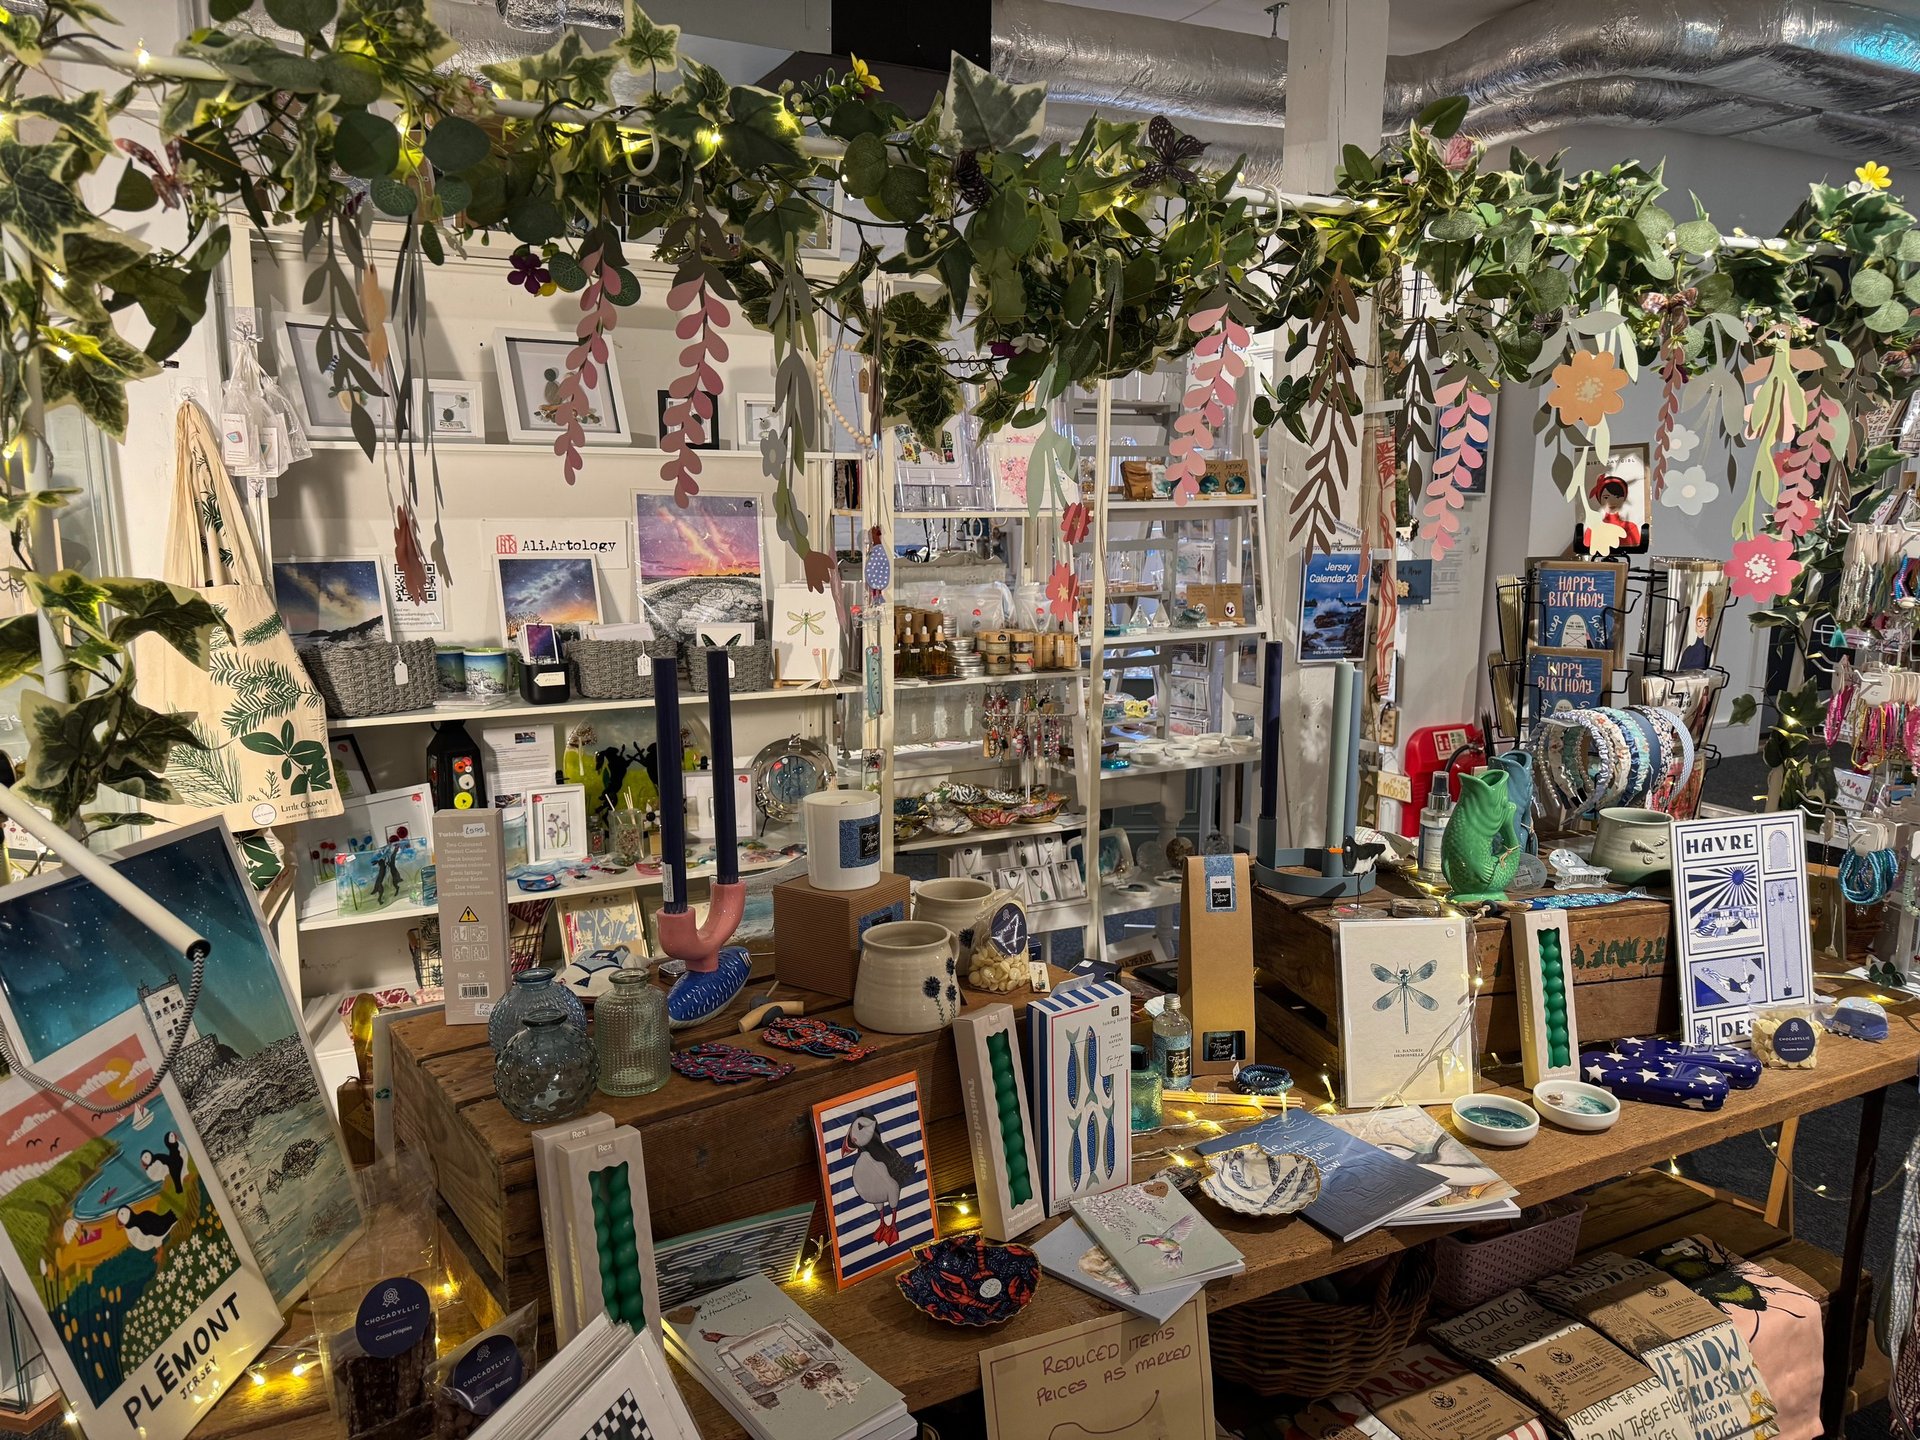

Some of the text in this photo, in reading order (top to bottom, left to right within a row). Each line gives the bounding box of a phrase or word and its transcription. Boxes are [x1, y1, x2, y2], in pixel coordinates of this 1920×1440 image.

[521, 539, 616, 553] Ali.Artology
[1309, 573, 1366, 583] Calendar 20
[1325, 562, 1352, 573] Jersey
[1558, 575, 1597, 592] HAPPY
[1548, 591, 1607, 608] BIRTHDAY
[1547, 660, 1584, 678] HAPPY
[1537, 675, 1595, 694] BIRTHDAY
[1686, 833, 1754, 855] HAVRE
[572, 1128, 587, 1139] Rex
[967, 1078, 988, 1182] Twisted Candles
[597, 1142, 613, 1153] Rex
[1569, 1276, 1604, 1295] OWLS
[1604, 1270, 1624, 1285] DO
[365, 1303, 420, 1326] CHOCADYLLIC
[1448, 1299, 1519, 1338] NODDING
[375, 1325, 413, 1341] Cocoa Krispies
[122, 1291, 241, 1430] PLÉMONT
[1042, 1326, 1176, 1375] REDUCED ITEMS
[1682, 1328, 1741, 1380] NOW
[179, 1354, 218, 1400] JERSEY
[463, 1355, 511, 1388] CHOCADYLLIC
[1036, 1344, 1191, 1407] PRICES AS MARKED
[495, 1375, 513, 1391] Buttons
[1689, 1364, 1758, 1408] BLOSSOM
[1617, 1389, 1636, 1405] THE
[1624, 1406, 1661, 1437] THESE
[1687, 1404, 1718, 1430] HANGS
[1718, 1399, 1733, 1416] ON
